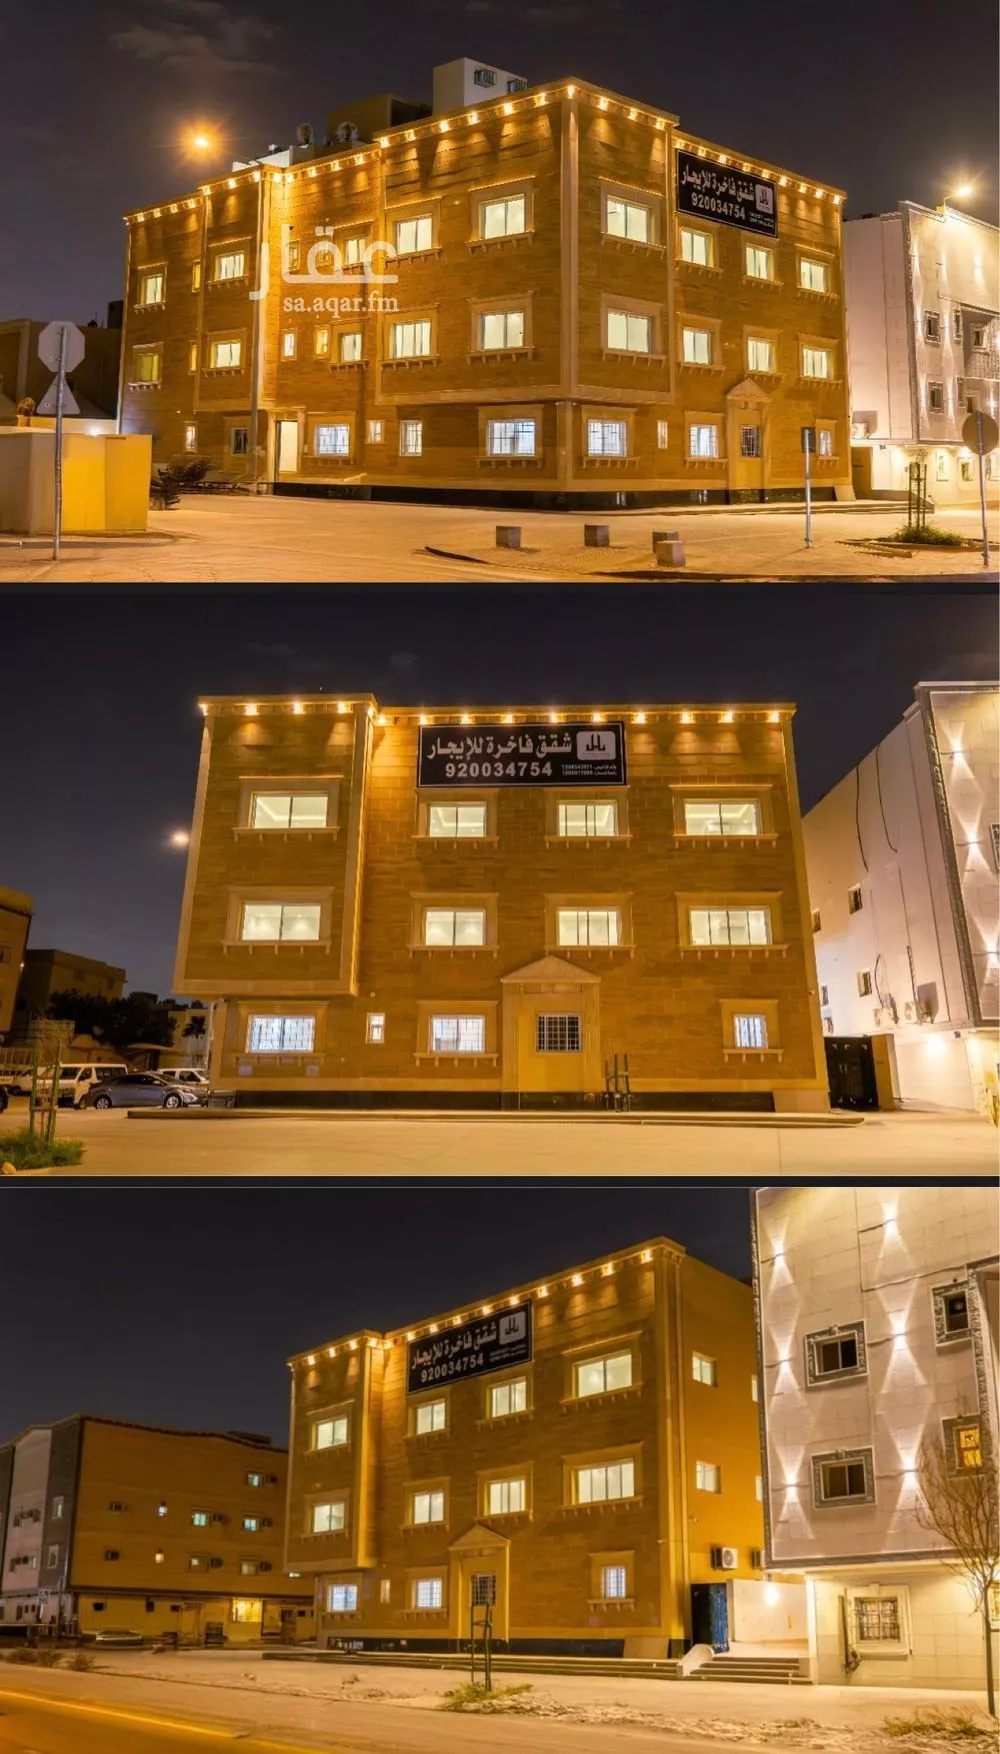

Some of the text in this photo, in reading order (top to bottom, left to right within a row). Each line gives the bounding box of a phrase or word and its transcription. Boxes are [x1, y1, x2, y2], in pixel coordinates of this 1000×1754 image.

[681, 164, 754, 202] شقق فاخرة للإيجار
[691, 192, 745, 220] 920034754
[427, 736, 484, 760] للإيجار
[487, 734, 534, 758] فاخرة
[535, 732, 572, 759] شقق
[445, 761, 552, 778] 920034754
[444, 1331, 473, 1358] فاخرة
[473, 1321, 497, 1350] شقق
[411, 1341, 443, 1370] للإيجار
[421, 1352, 484, 1383] 920034754
